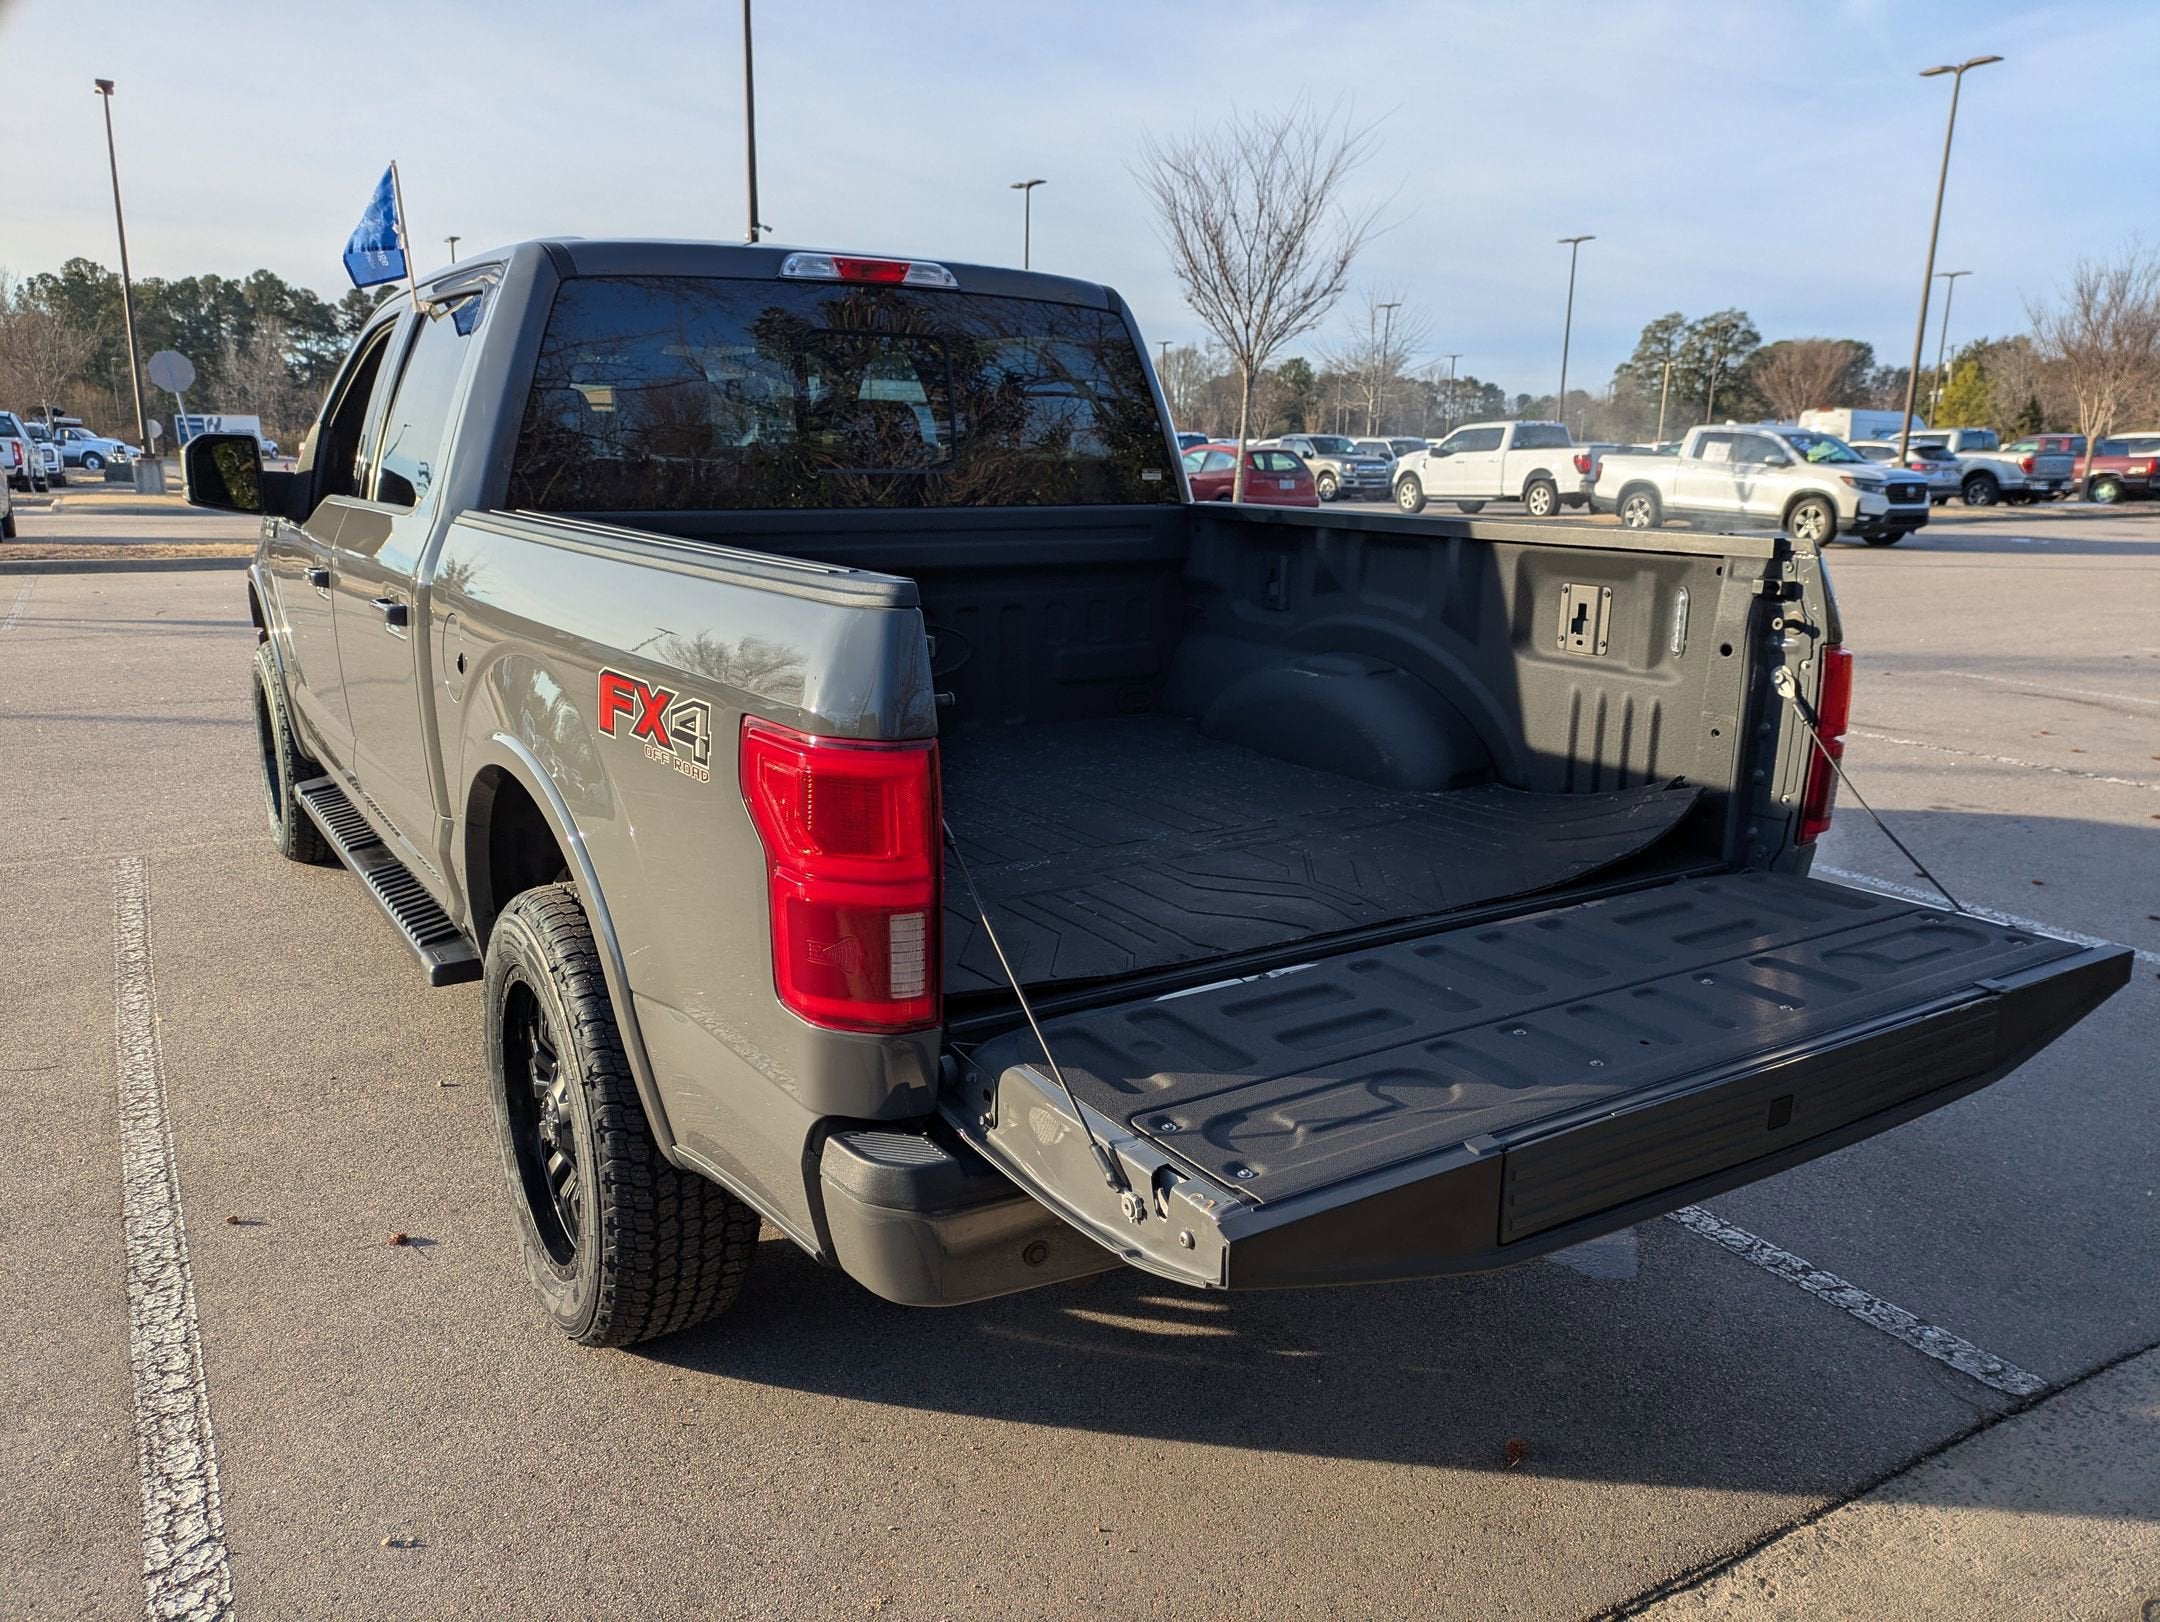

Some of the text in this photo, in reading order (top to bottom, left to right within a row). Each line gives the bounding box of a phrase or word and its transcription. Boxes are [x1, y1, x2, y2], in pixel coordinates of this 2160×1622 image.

[598, 666, 711, 770] FX4
[644, 744, 710, 783] OFF ROAD
